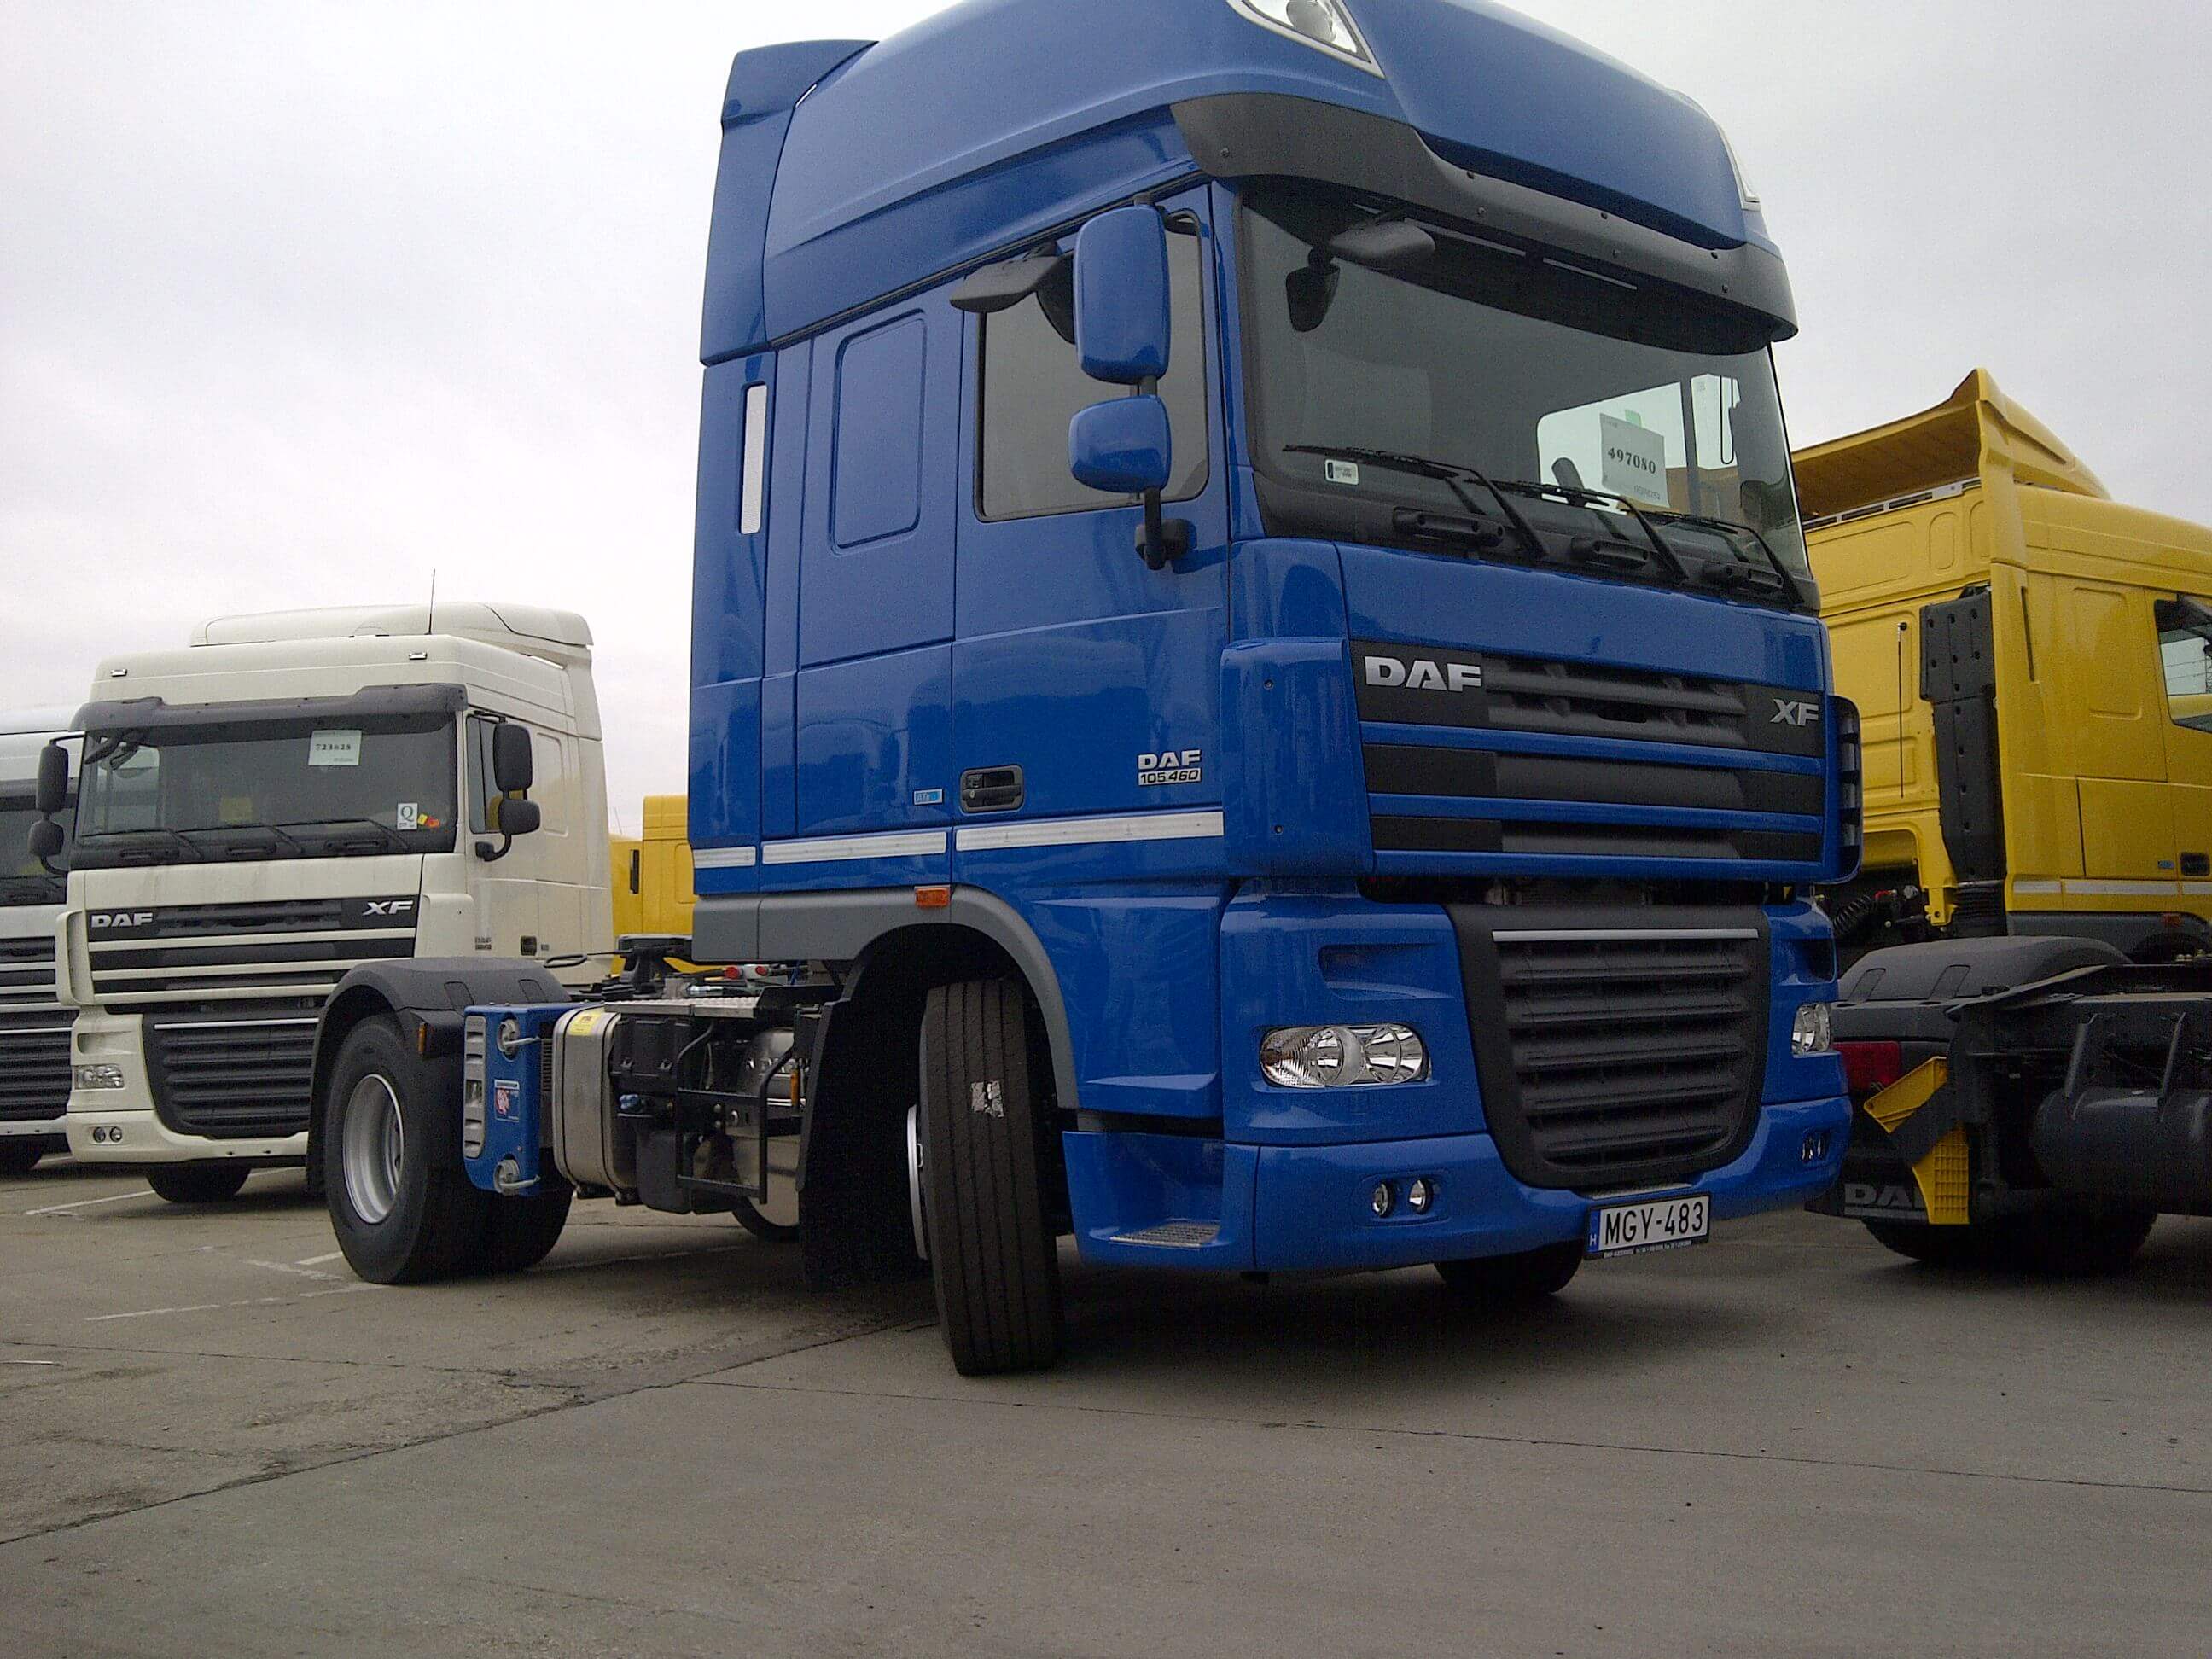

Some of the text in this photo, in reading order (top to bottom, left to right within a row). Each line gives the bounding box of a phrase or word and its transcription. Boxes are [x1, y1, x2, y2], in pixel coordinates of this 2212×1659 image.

[1607, 446, 1656, 474] 497080
[1364, 655, 1482, 692] DAF
[1769, 698, 1819, 726] XF
[1138, 749, 1202, 770] DAF
[1140, 770, 1199, 783] 105.460
[401, 806, 415, 822] Q
[362, 899, 414, 916] XF
[90, 911, 154, 928] DAF
[1604, 1201, 1704, 1246] MGY-483
[1589, 1233, 1598, 1247] H
